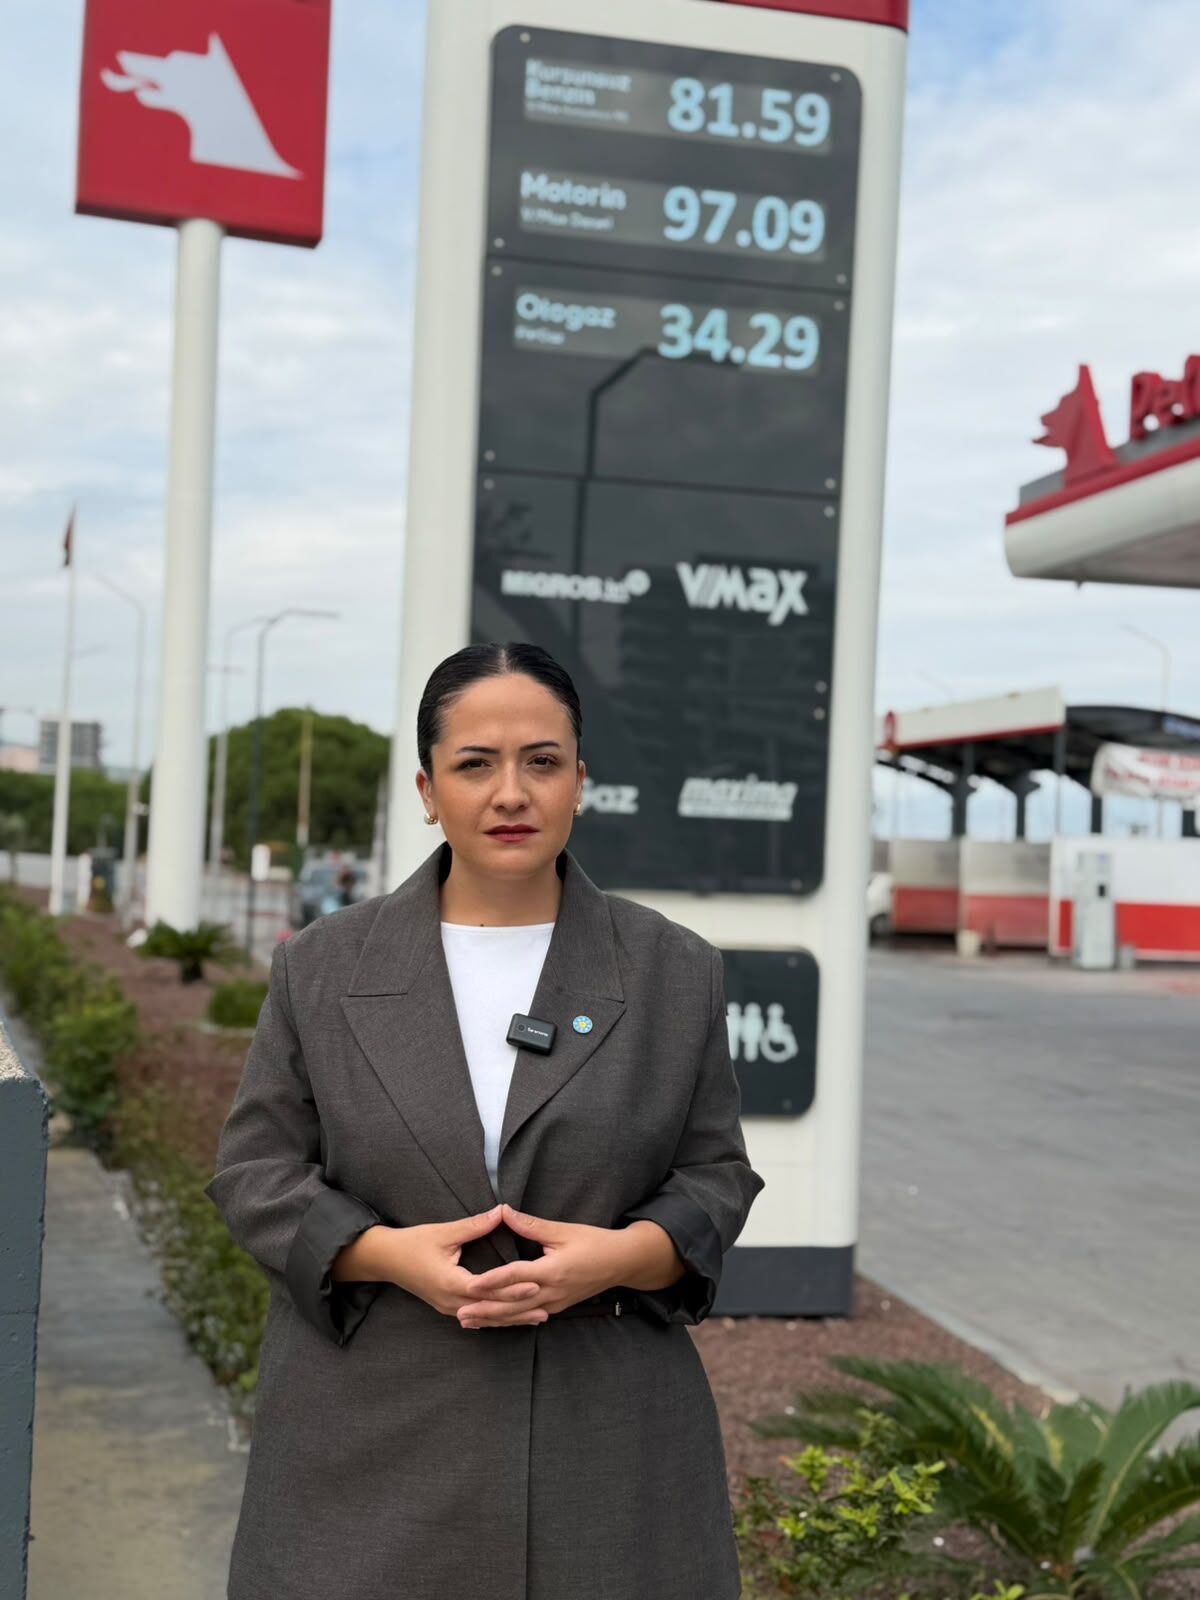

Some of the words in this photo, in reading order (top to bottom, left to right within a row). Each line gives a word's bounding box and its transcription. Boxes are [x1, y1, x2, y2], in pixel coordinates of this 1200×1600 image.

[667, 77, 831, 146] 81.59
[520, 171, 627, 210] Motorin
[662, 186, 826, 254] 97.09
[516, 293, 616, 332] Otogaz
[657, 304, 820, 370] 34.29
